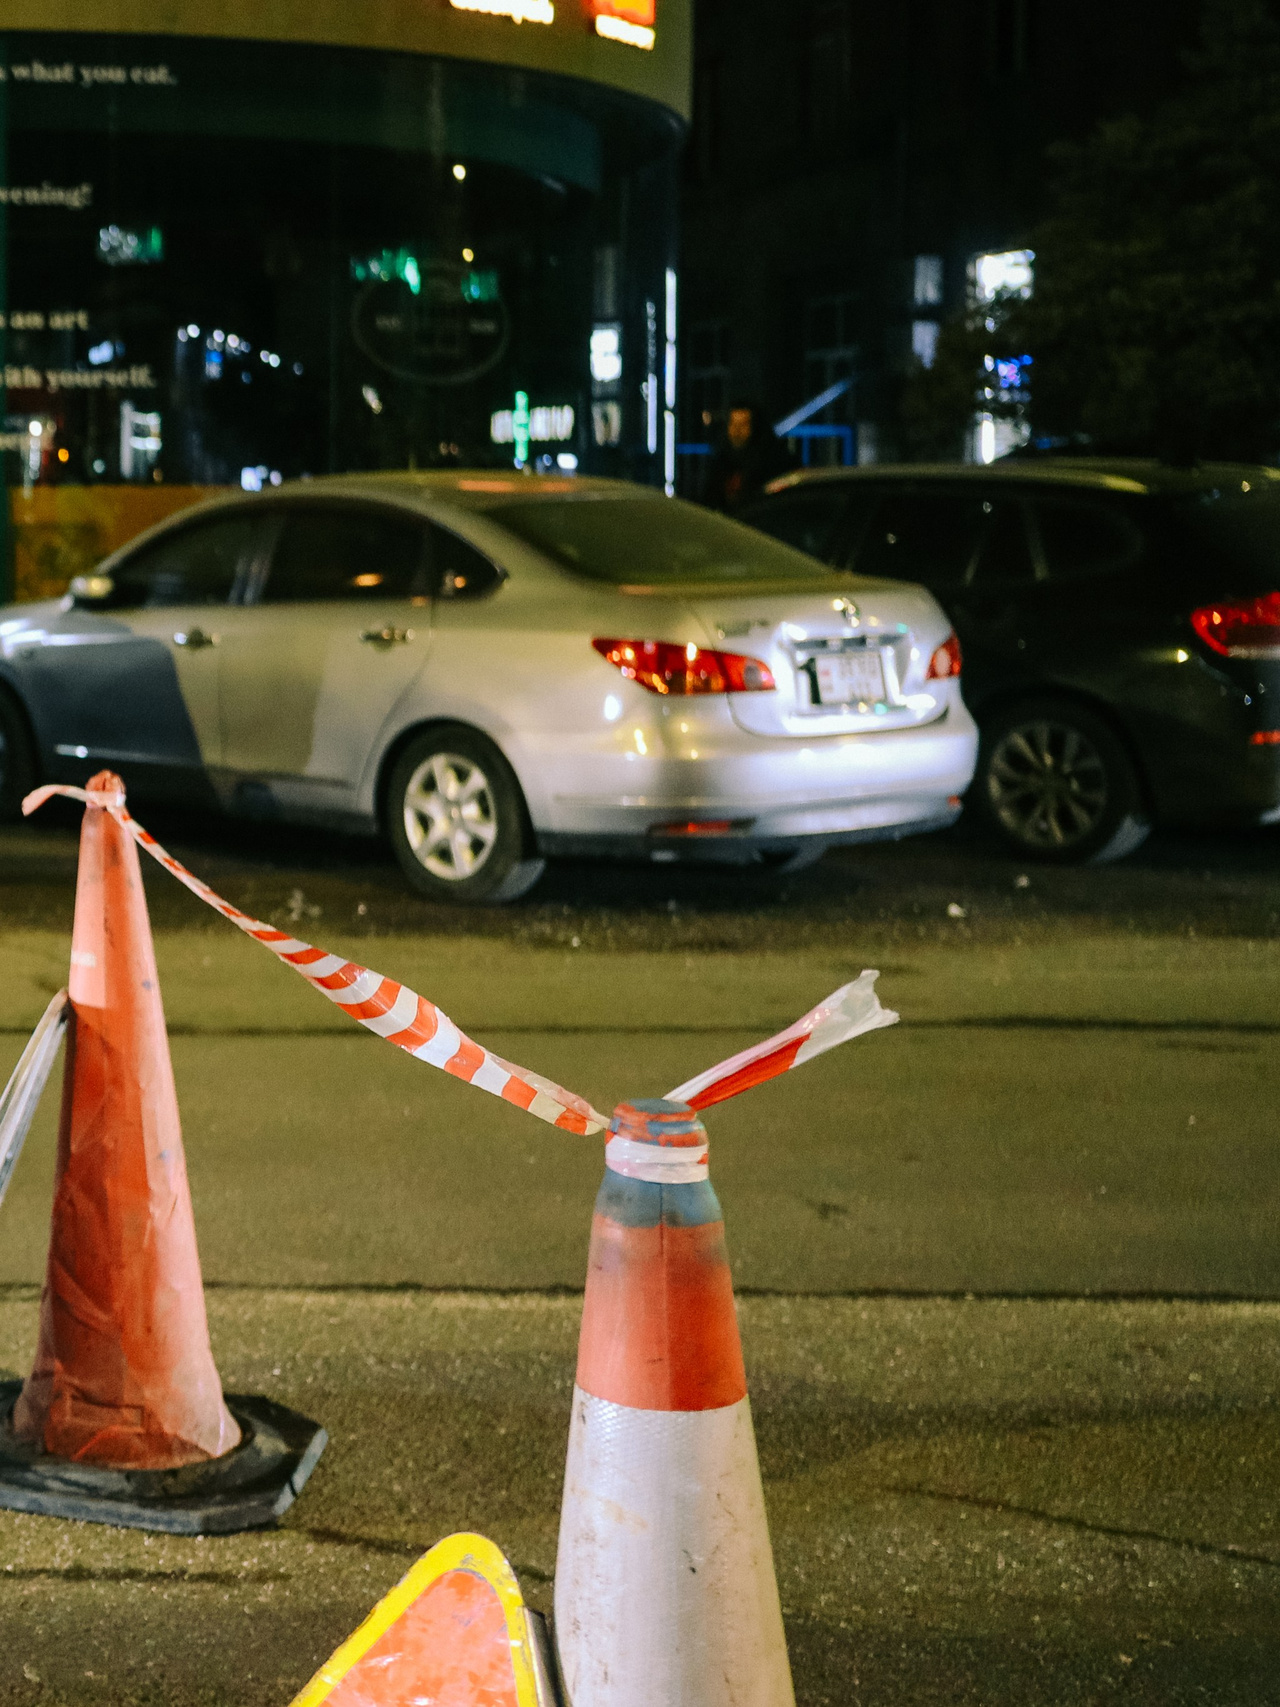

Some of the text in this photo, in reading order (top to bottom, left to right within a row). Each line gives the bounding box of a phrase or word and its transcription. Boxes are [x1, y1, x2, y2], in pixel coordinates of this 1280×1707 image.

[11, 60, 75, 82] what
[79, 65, 127, 88] you
[10, 310, 46, 329] an
[48, 309, 90, 330] art
